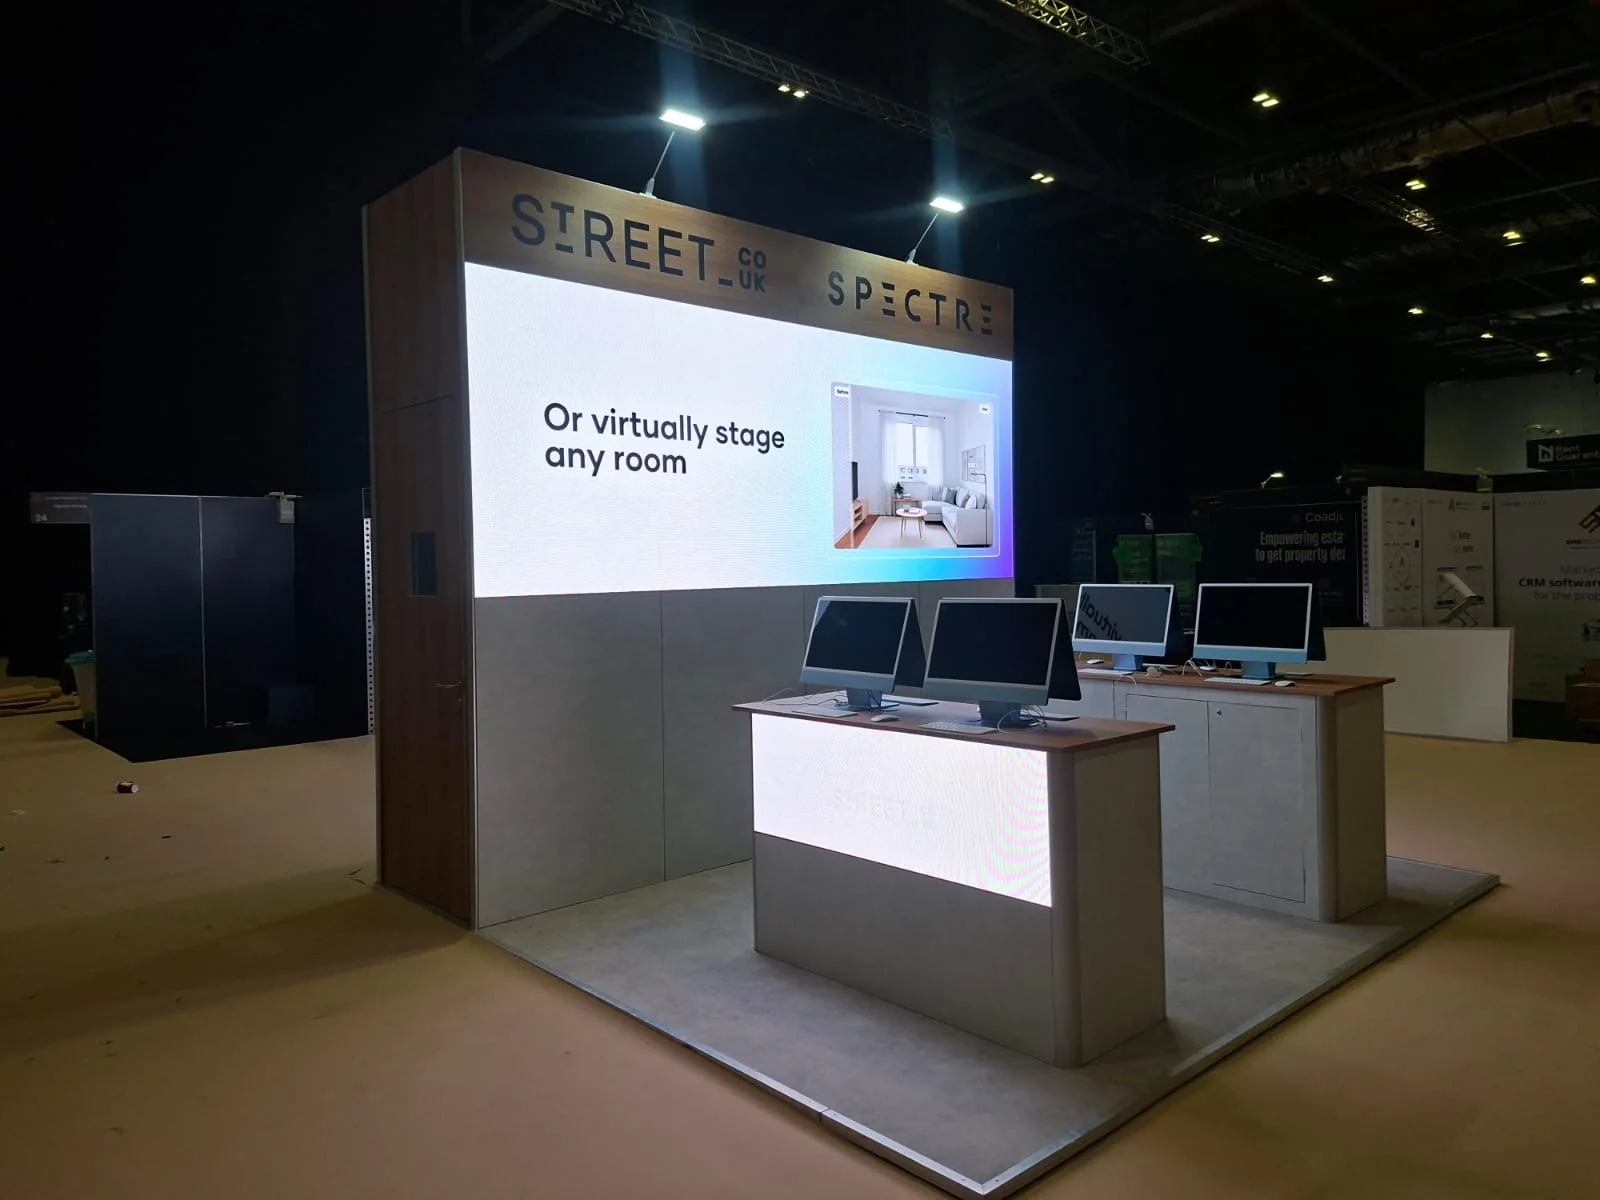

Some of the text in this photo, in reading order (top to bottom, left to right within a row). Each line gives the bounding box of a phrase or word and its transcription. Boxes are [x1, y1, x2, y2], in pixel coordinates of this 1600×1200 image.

[738, 246, 767, 270] CO
[739, 270, 766, 293] UK
[828, 270, 993, 336] SPECTRE
[544, 402, 785, 454] Or virtually stage
[545, 445, 687, 477] any room
[1260, 530, 1319, 547] Empowering
[1255, 548, 1265, 562] to
[1267, 548, 1283, 564] get
[1284, 546, 1328, 563] property
[1518, 578, 1545, 587] CRM
